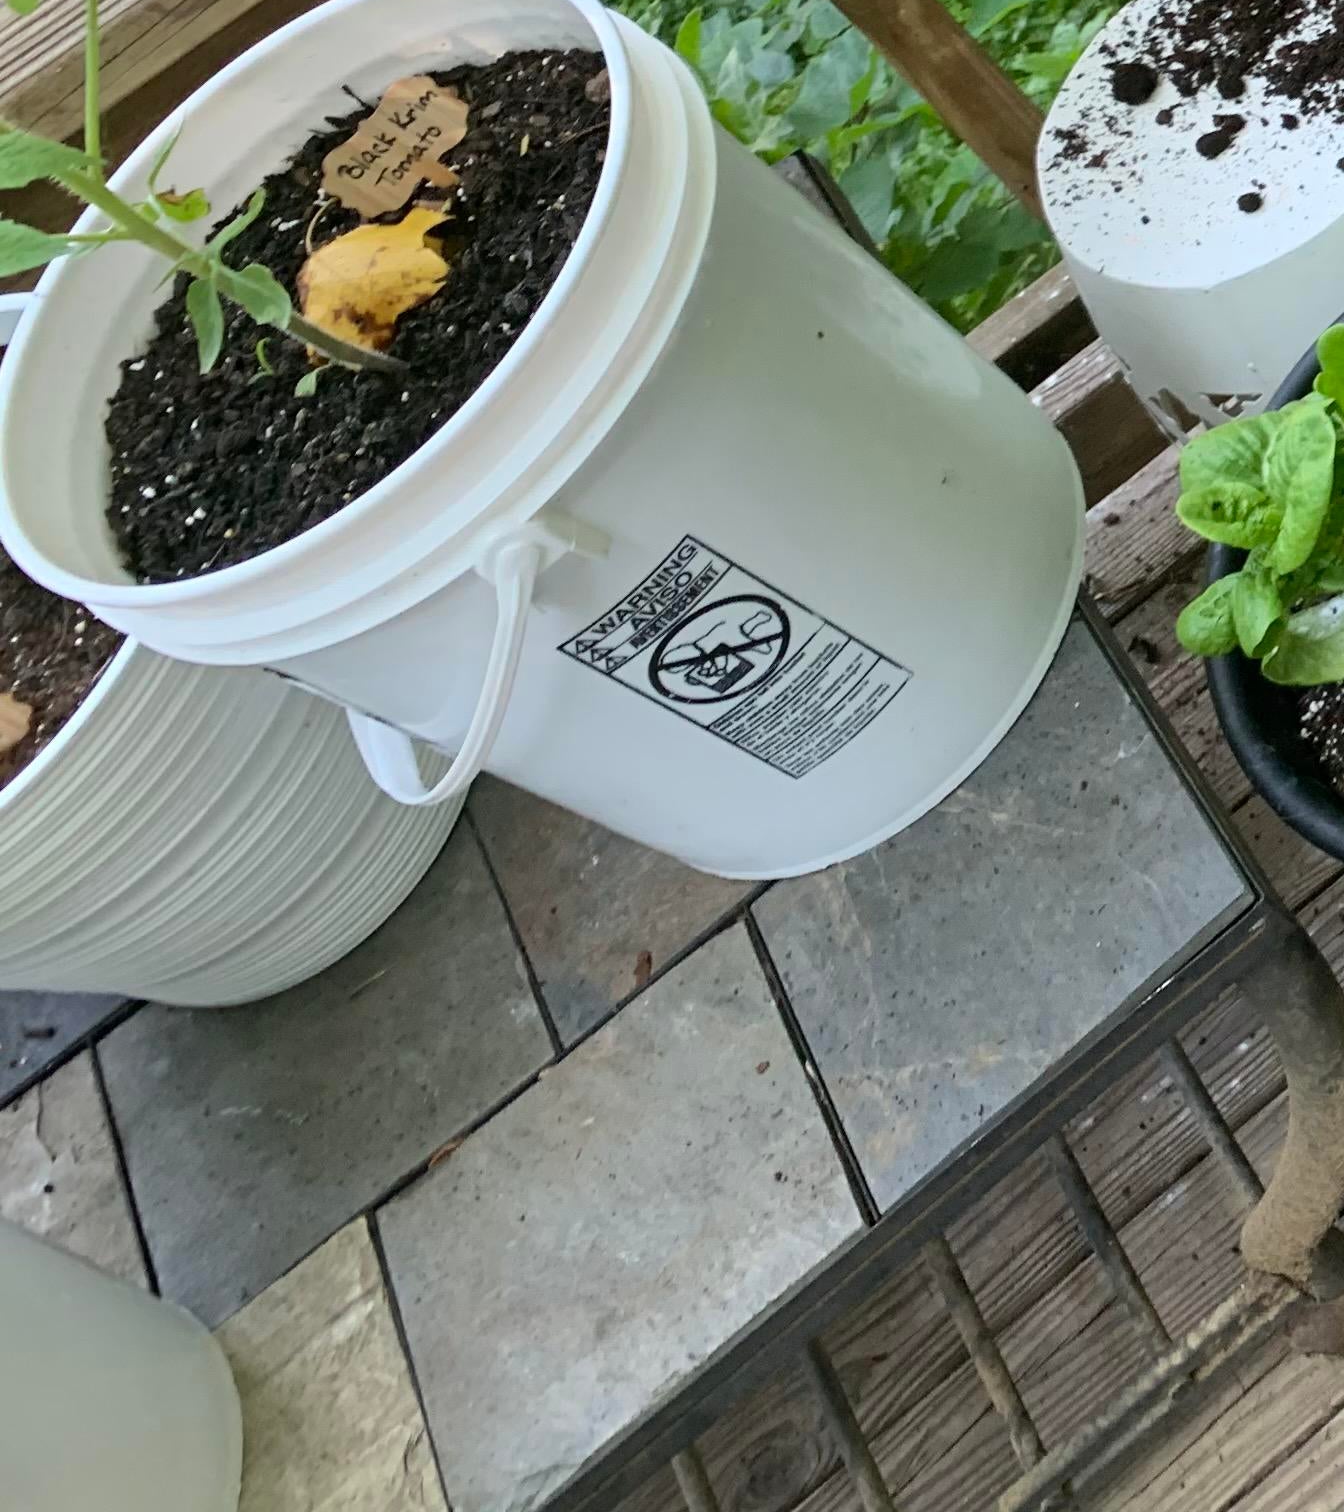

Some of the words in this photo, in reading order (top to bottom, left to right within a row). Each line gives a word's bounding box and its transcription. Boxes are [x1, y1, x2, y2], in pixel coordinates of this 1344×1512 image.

[337, 132, 397, 180] Black
[388, 90, 438, 131] Krim
[374, 125, 442, 187] Tomato
[591, 544, 698, 638] WARNING
[629, 571, 693, 630] AVISO
